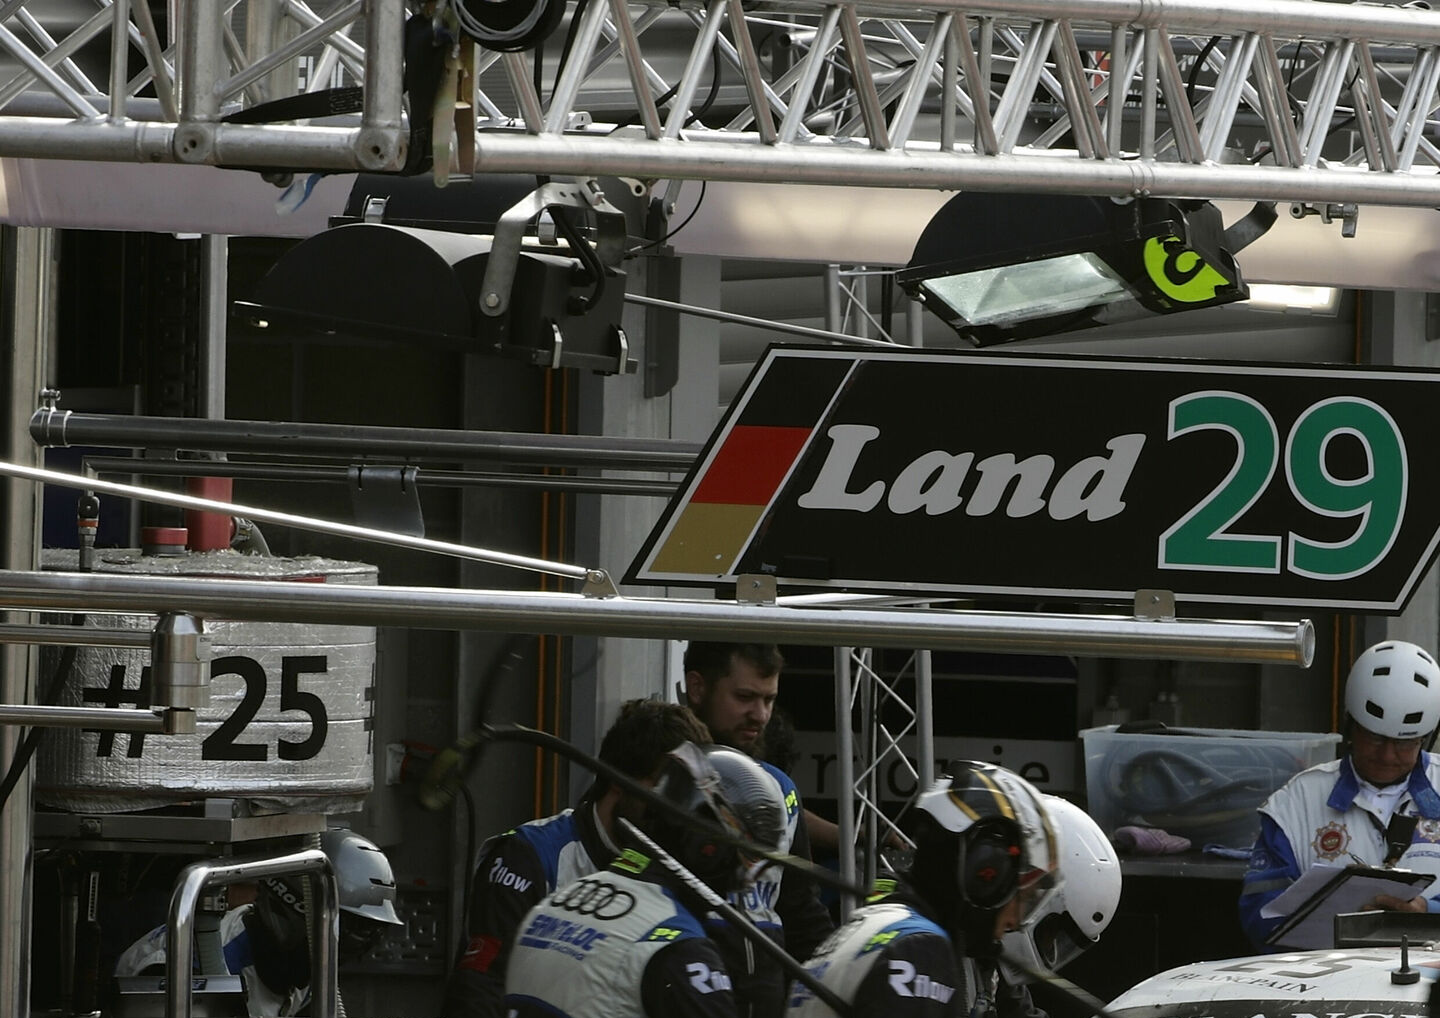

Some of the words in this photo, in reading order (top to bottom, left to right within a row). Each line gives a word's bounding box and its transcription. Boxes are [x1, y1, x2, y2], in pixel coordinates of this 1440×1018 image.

[797, 424, 1147, 522] Land
[1157, 390, 1409, 580] 29
[201, 655, 329, 762] 25
[1169, 971, 1319, 994] BLANCPAIN
